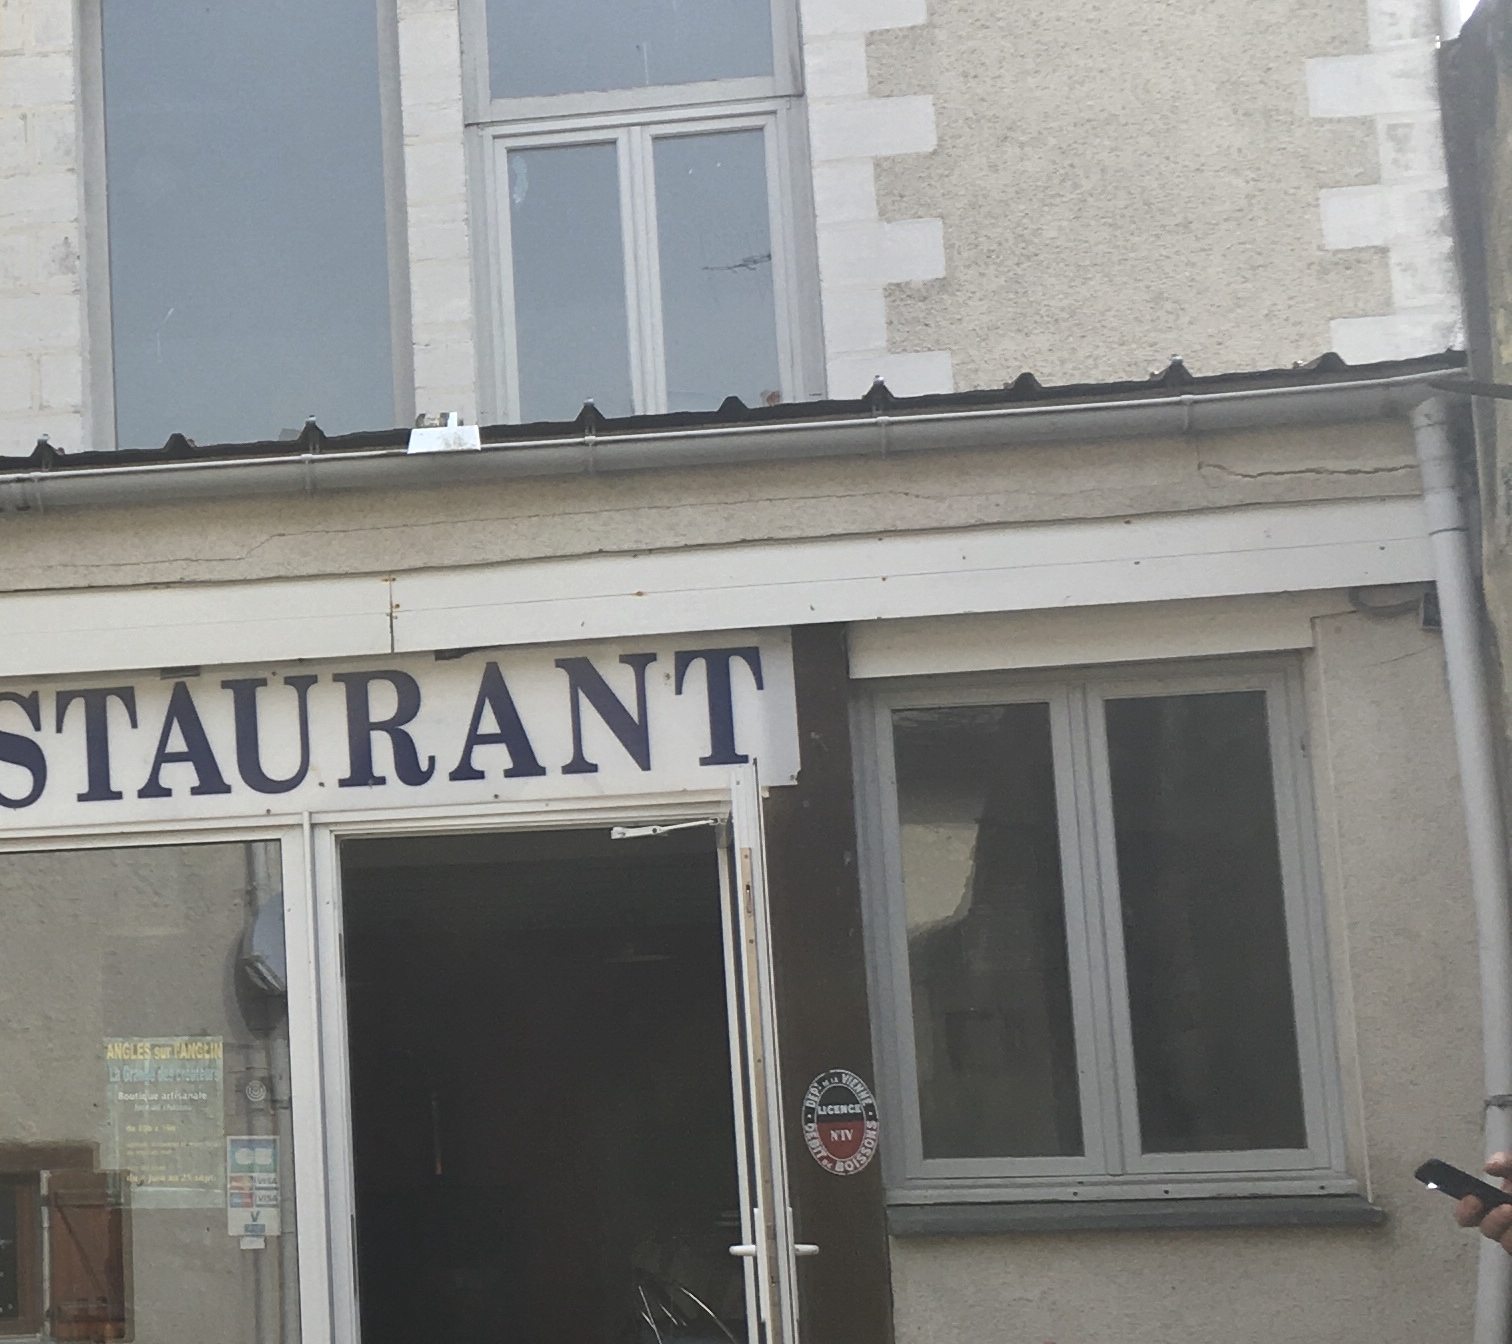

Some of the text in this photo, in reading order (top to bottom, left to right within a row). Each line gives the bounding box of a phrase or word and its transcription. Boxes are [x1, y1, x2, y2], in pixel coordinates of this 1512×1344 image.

[107, 1042, 152, 1060] ANGLES
[154, 1046, 172, 1060] sur
[118, 1091, 208, 1102] Boutique artisanale
[841, 1073, 873, 1107] VIENNE
[817, 1104, 862, 1115] LICENCE
[835, 1120, 877, 1172] BOISSONS
[258, 1193, 277, 1202] VISA
